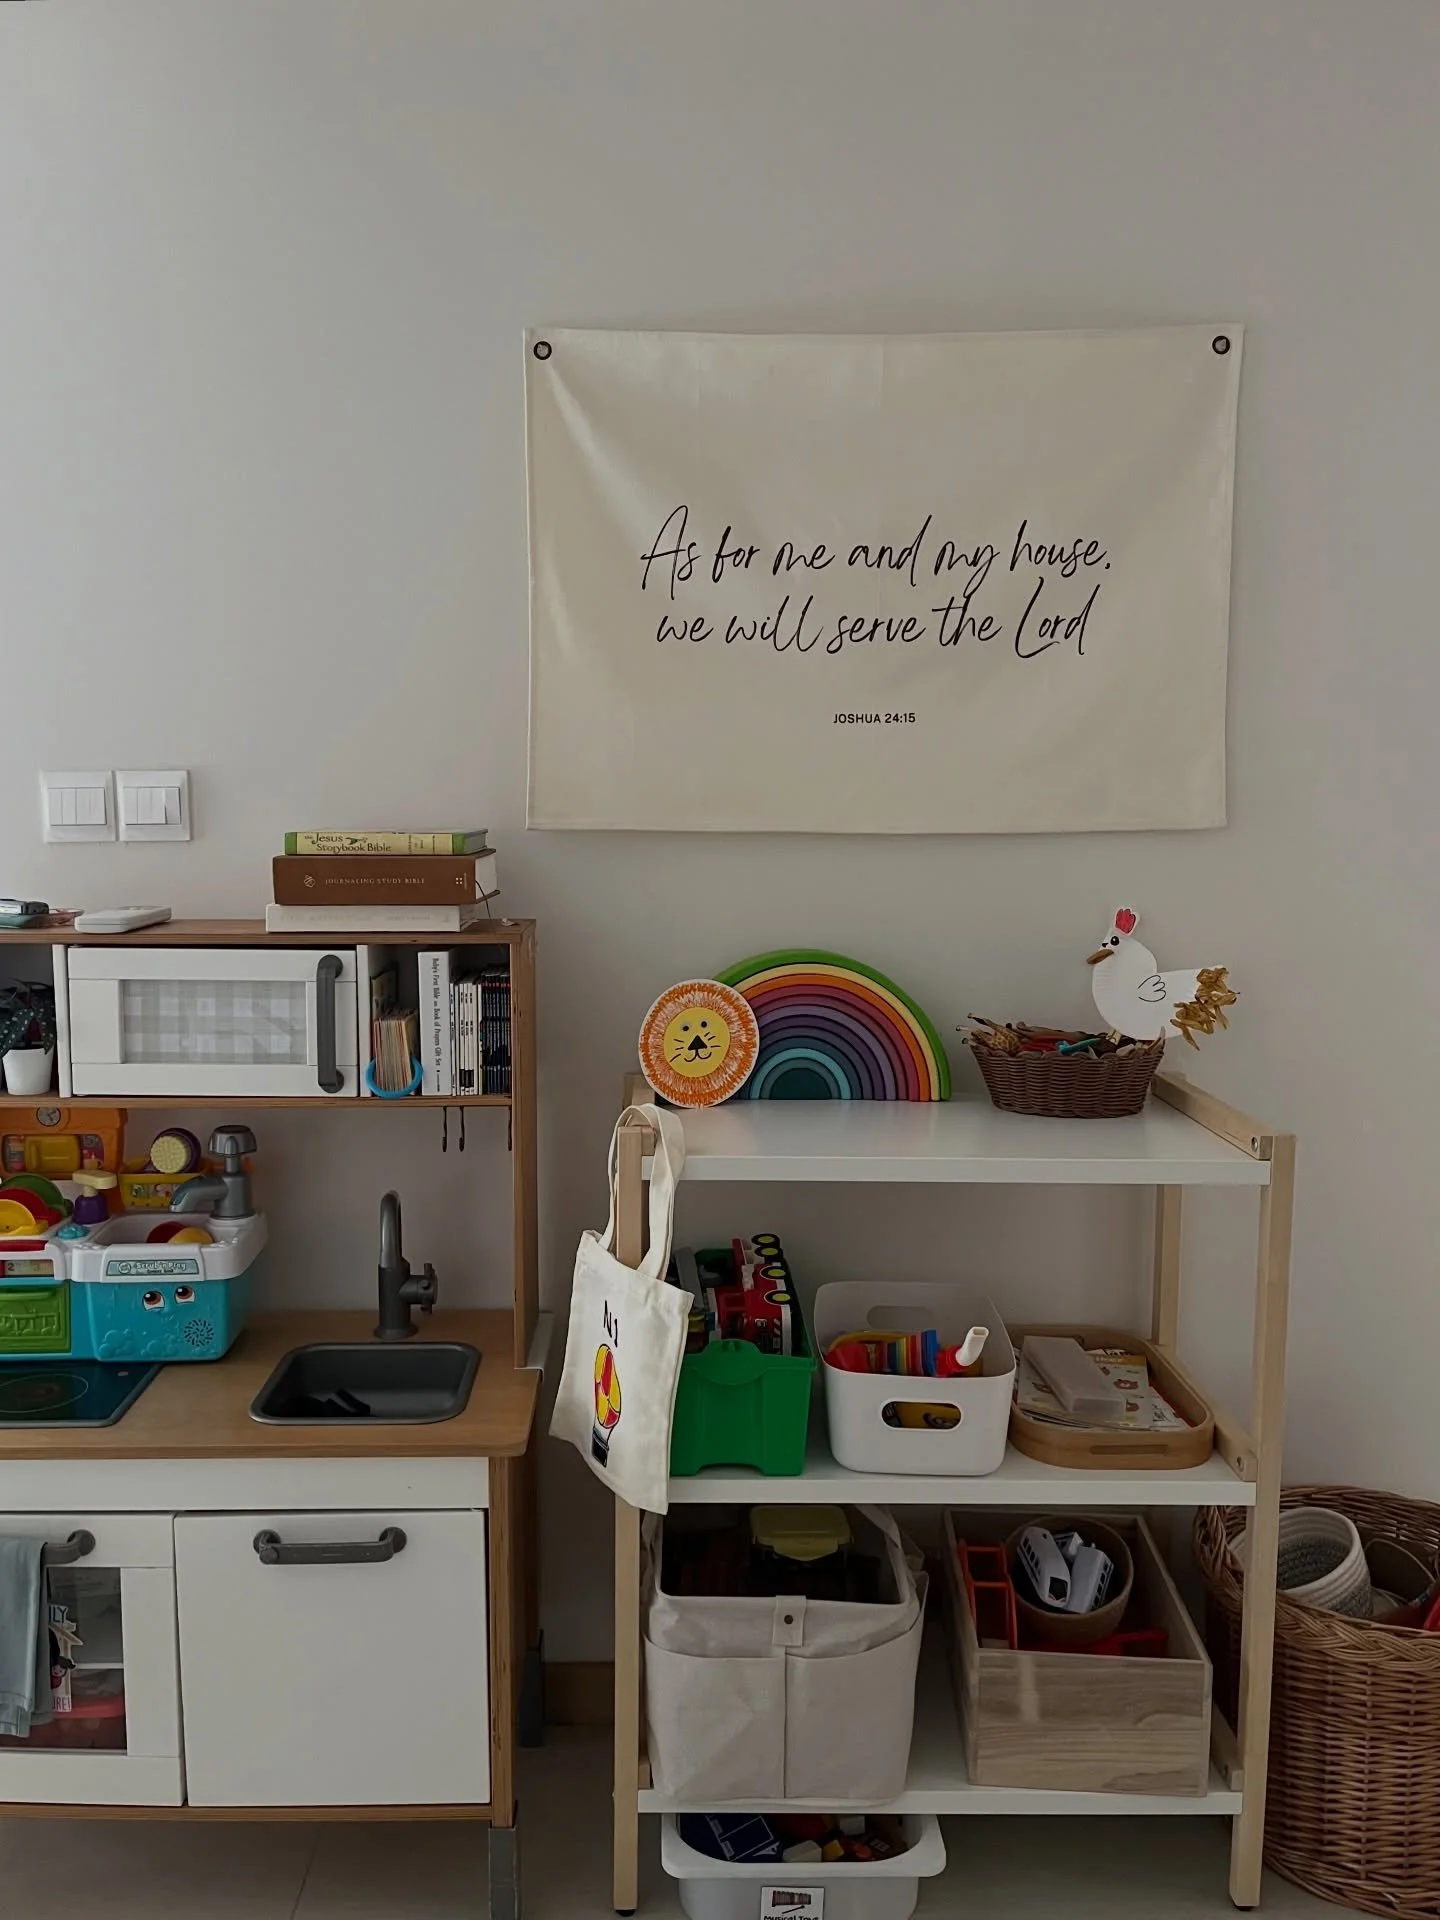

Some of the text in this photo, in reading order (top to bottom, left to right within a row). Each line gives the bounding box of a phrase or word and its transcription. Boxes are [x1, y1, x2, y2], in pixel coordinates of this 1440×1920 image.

[640, 505, 701, 600] As
[712, 526, 760, 583] for
[773, 542, 835, 576] me
[848, 514, 932, 587] and
[933, 541, 1000, 598] my
[656, 577, 1100, 658] we will serve the Lord
[833, 712, 916, 724] JOSHUA 24:15
[311, 833, 343, 845] Jesus
[316, 843, 392, 853] Storybook Bible
[325, 877, 375, 885] JOURNALING
[7, 1262, 15, 1271] 2
